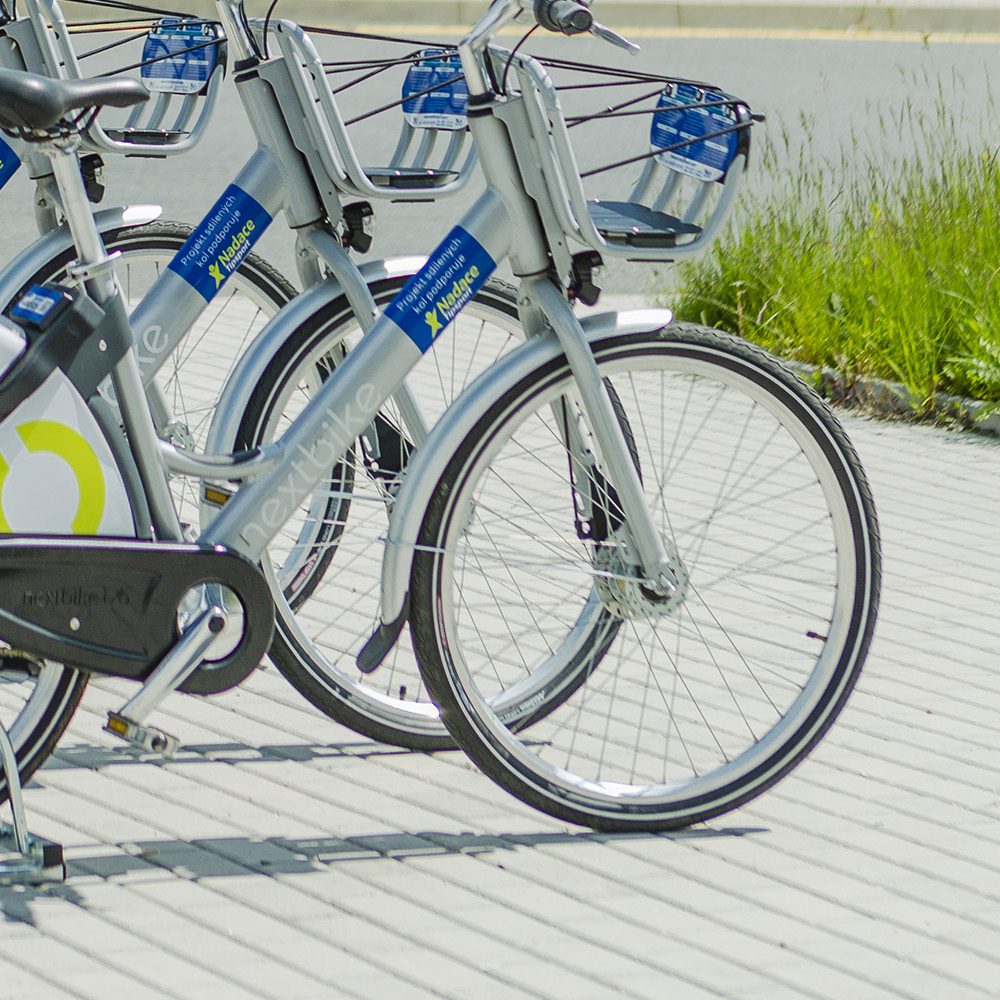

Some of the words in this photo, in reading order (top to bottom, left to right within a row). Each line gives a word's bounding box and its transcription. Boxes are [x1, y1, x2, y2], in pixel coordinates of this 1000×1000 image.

[180, 235, 207, 266] Projekt
[195, 251, 209, 267] kol
[207, 210, 240, 255] podporuje
[218, 220, 255, 267] Nadace
[225, 239, 251, 272] Tipsport
[396, 278, 427, 312] Projekt
[412, 297, 428, 314] kol
[426, 255, 465, 302] podporuje
[436, 265, 480, 313] Nadace
[240, 383, 381, 547] nextbike
